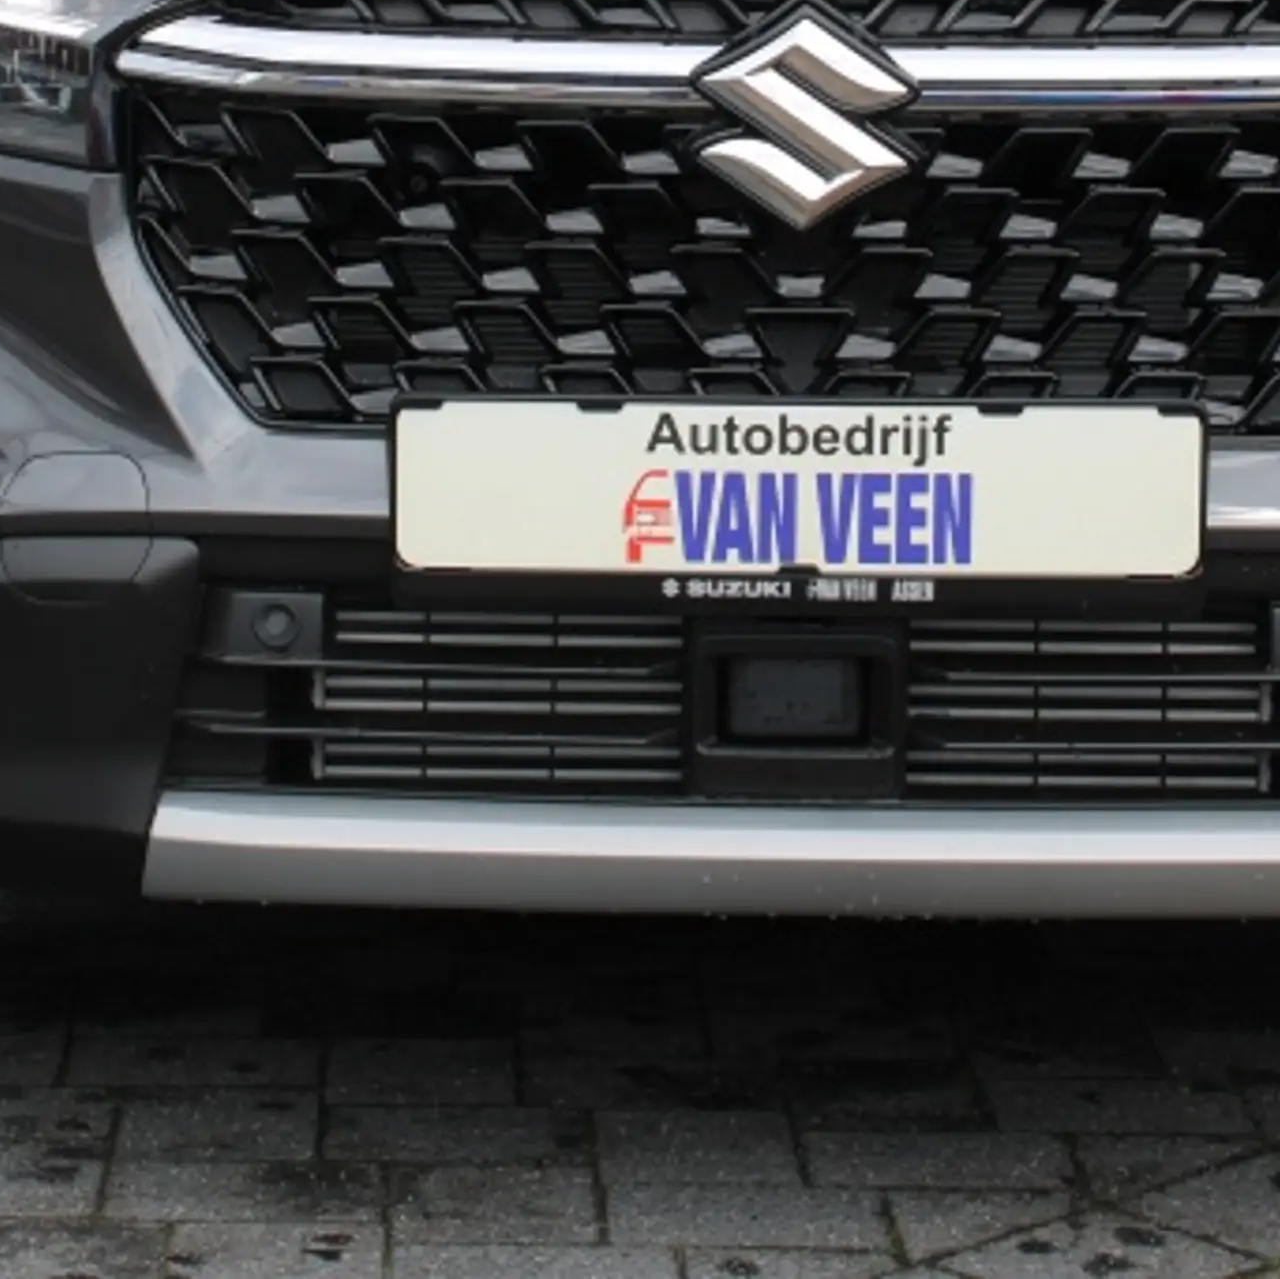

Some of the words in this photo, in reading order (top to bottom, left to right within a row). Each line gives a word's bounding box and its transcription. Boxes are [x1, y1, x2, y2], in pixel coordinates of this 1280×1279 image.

[645, 412, 953, 467] Autobedrijf
[674, 470, 798, 563] VAN
[816, 473, 972, 564] VEEN
[685, 579, 792, 598] SUZUKI
